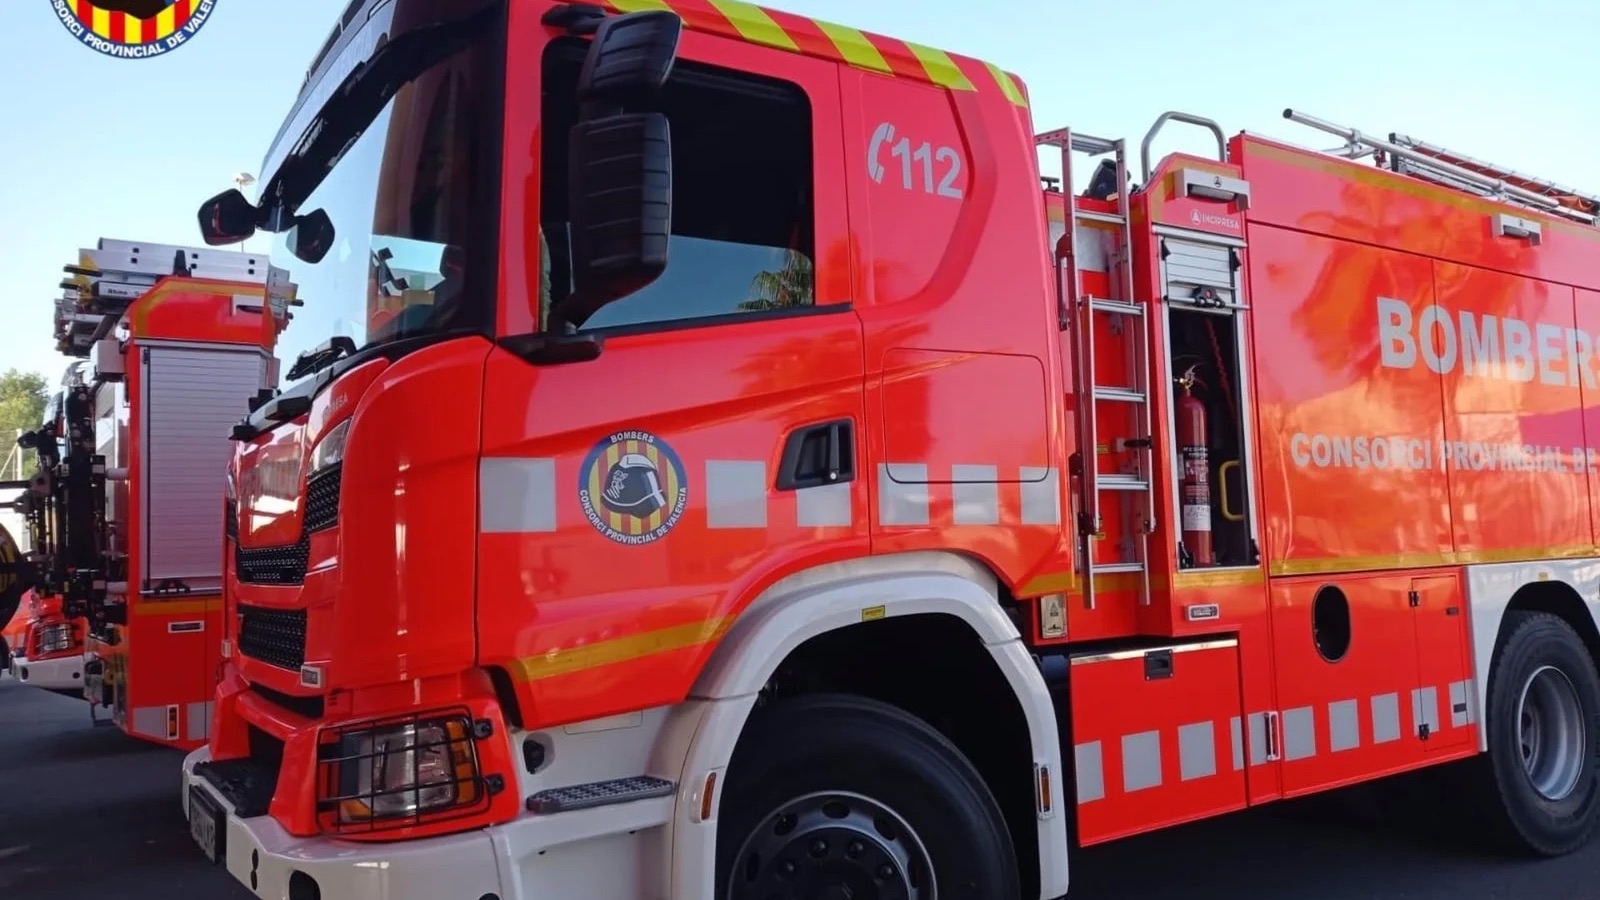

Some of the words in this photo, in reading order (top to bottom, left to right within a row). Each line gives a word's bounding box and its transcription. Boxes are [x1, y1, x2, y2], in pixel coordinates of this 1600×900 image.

[891, 137, 964, 199] 112
[1376, 296, 1600, 390] BOMBER
[610, 431, 655, 443] BOMBERS
[1440, 440, 1568, 473] PROVINCIAL
[1572, 446, 1598, 475] DE
[580, 489, 606, 532] CONSORCI
[607, 528, 657, 544] PROVINCIAL
[656, 524, 668, 536] DE
[667, 487, 687, 527] VALENCIA
